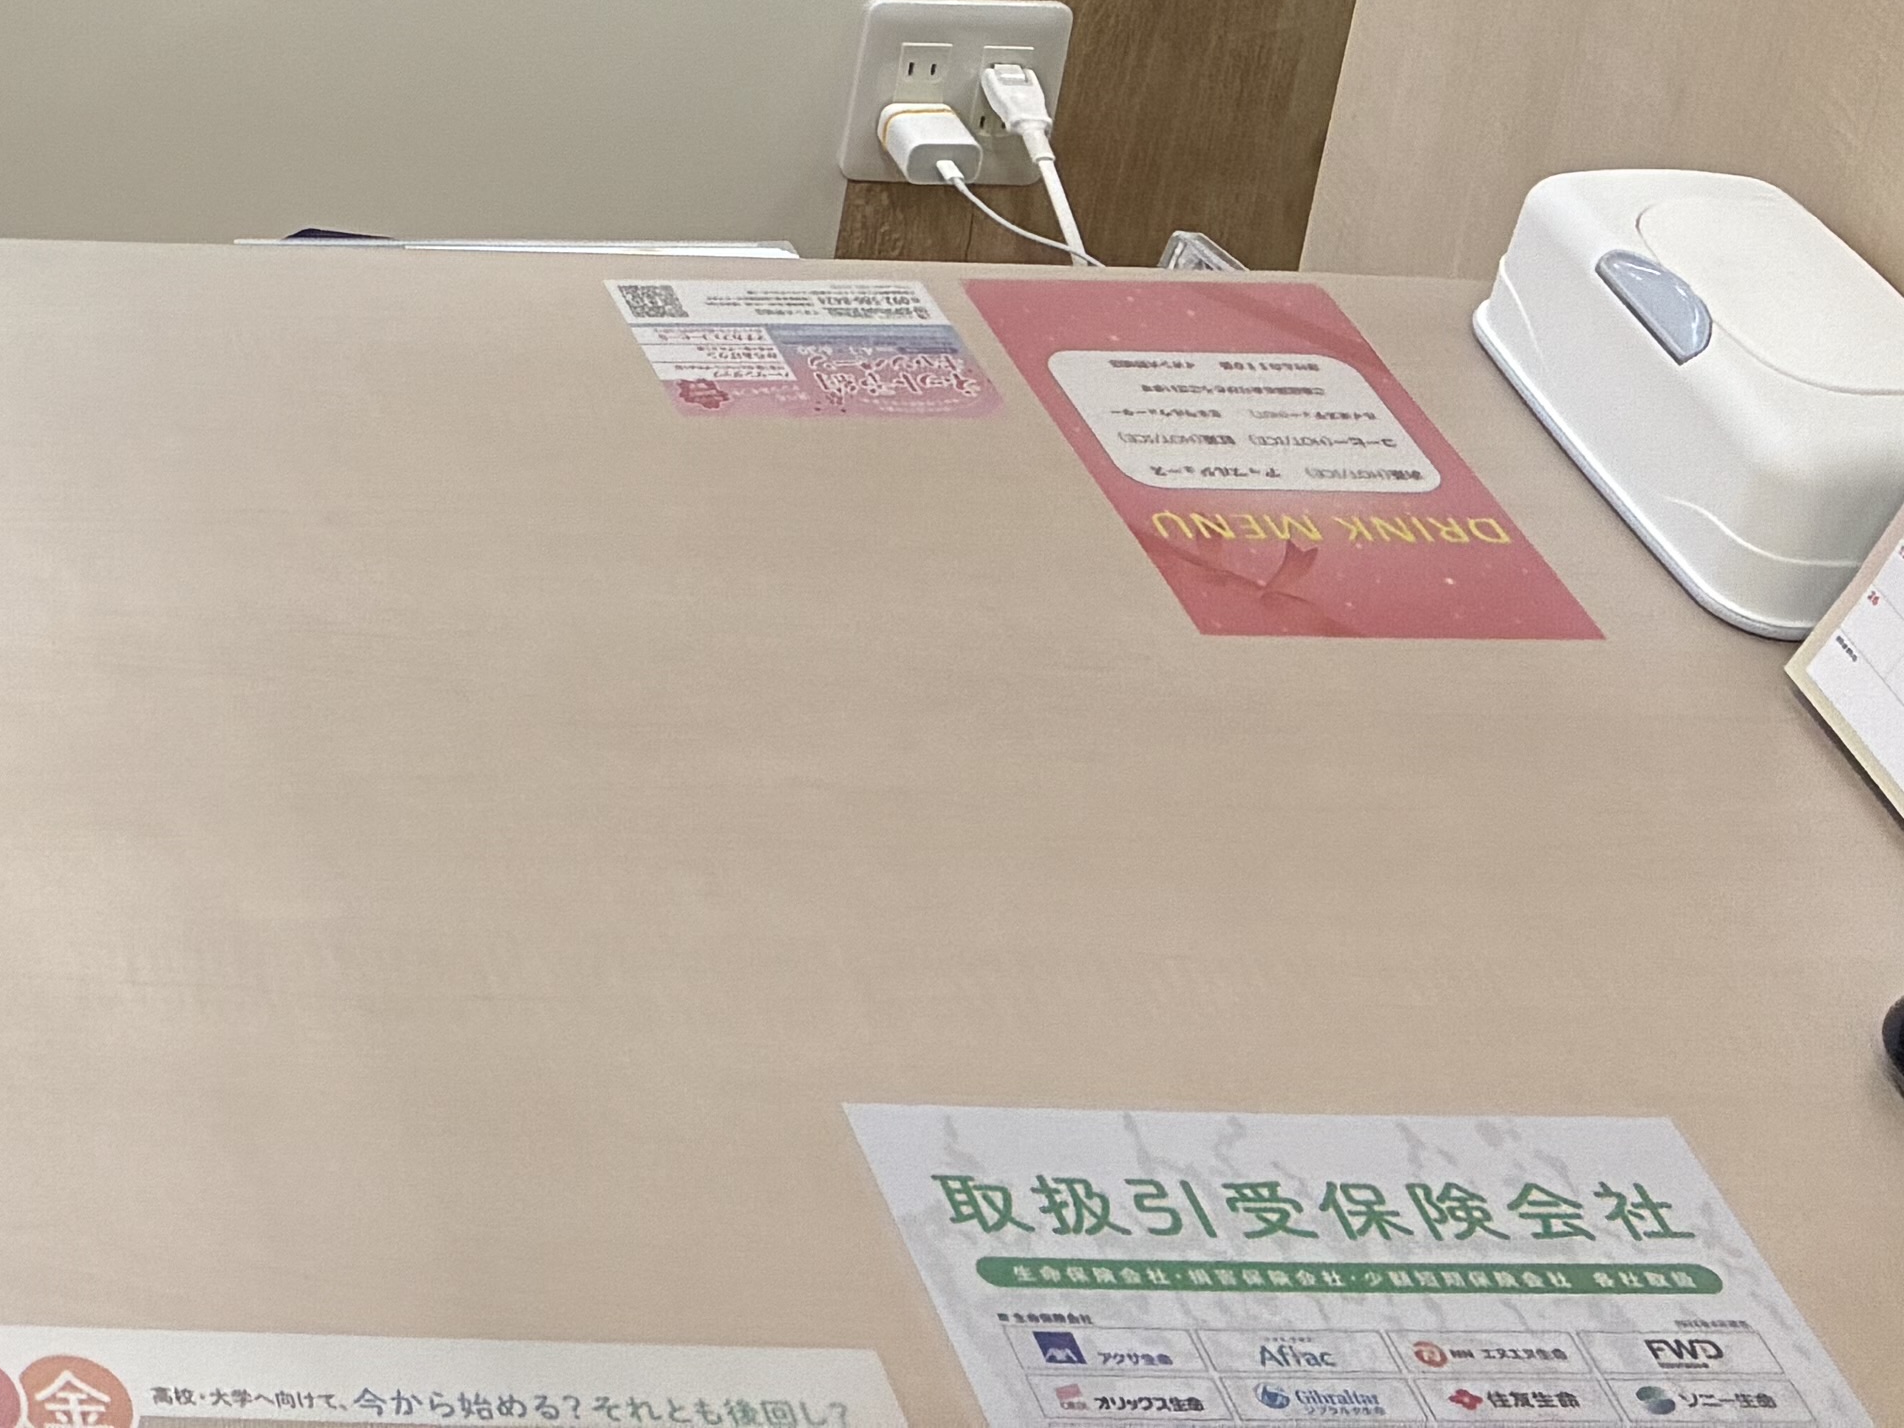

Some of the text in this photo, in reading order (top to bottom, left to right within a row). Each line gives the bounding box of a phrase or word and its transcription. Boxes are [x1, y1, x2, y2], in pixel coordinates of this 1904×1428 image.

[1150, 509, 1510, 546] DRINK MENU
[930, 1173, 1696, 1242] 取扱引受保険会社
[1258, 1344, 1339, 1368] Aflac
[1645, 1338, 1725, 1361] FWD
[1093, 1394, 1206, 1415] オリックス生命
[1295, 1389, 1381, 1407] Gibraltar
[1486, 1389, 1581, 1410] 住友生命
[1678, 1393, 1778, 1411] ソニー生命
